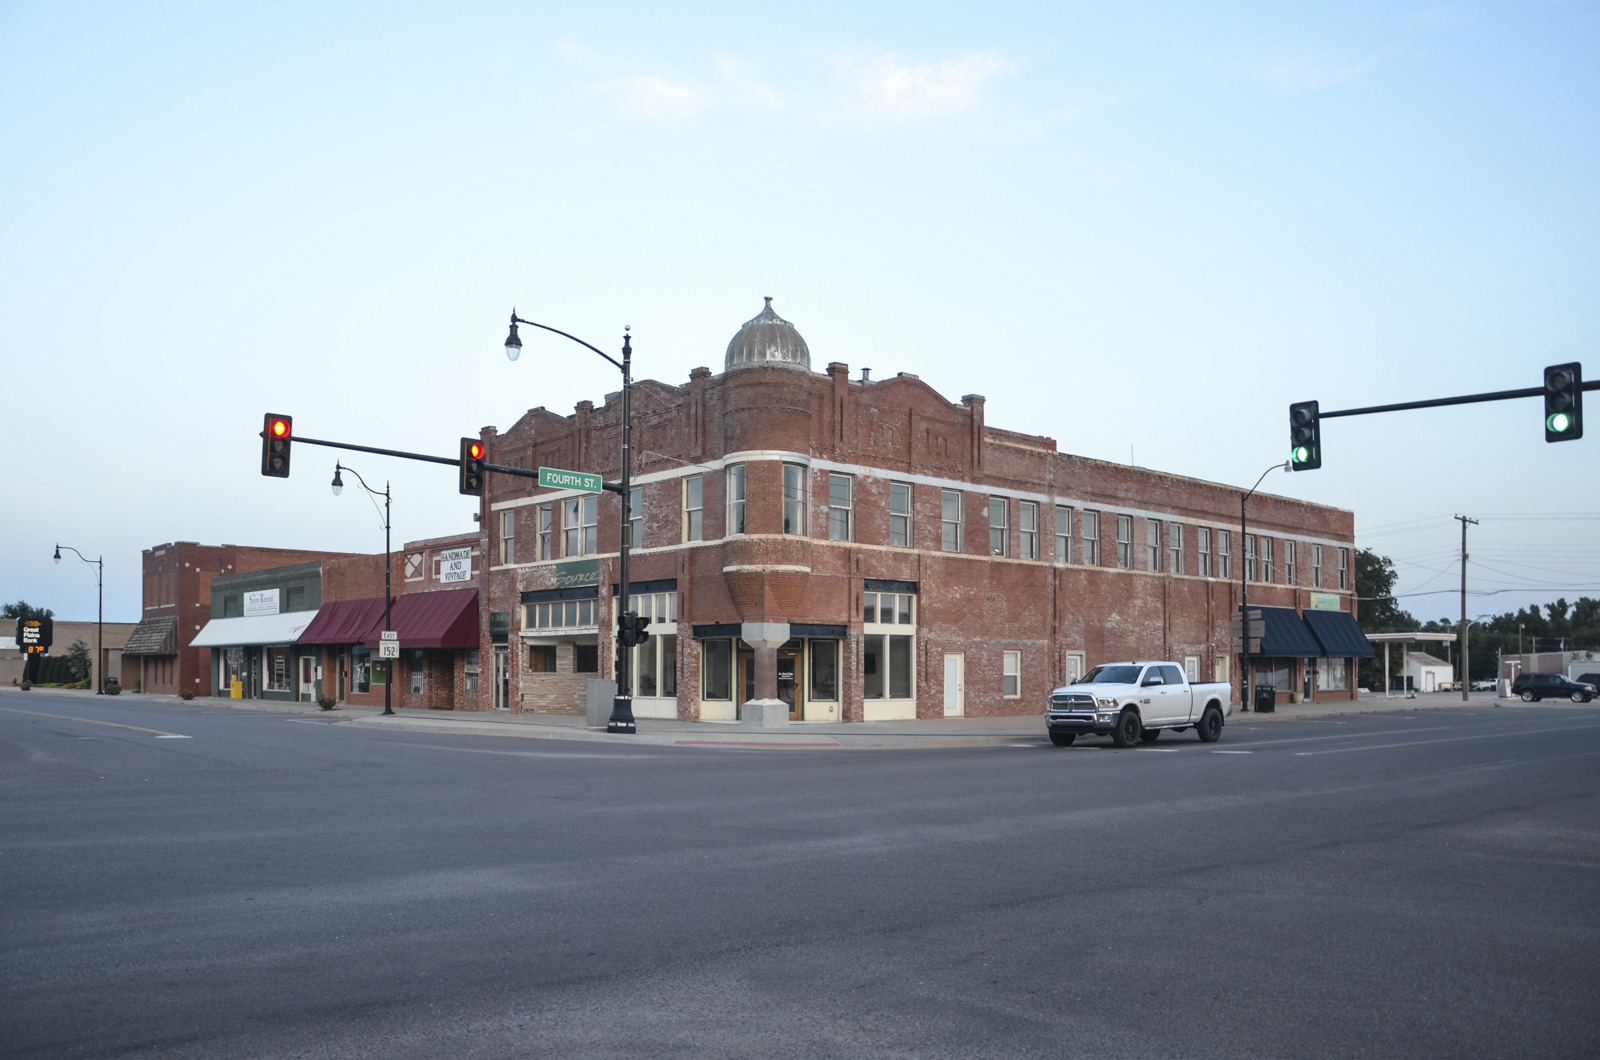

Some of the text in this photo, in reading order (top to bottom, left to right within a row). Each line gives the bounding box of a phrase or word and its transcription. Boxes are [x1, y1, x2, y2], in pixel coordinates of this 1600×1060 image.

[546, 473, 597, 489] FOURTH ST.
[441, 550, 471, 562] HANDMADE
[450, 561, 462, 571] AND
[445, 570, 467, 581] VINTAGE
[383, 646, 396, 657] 152
